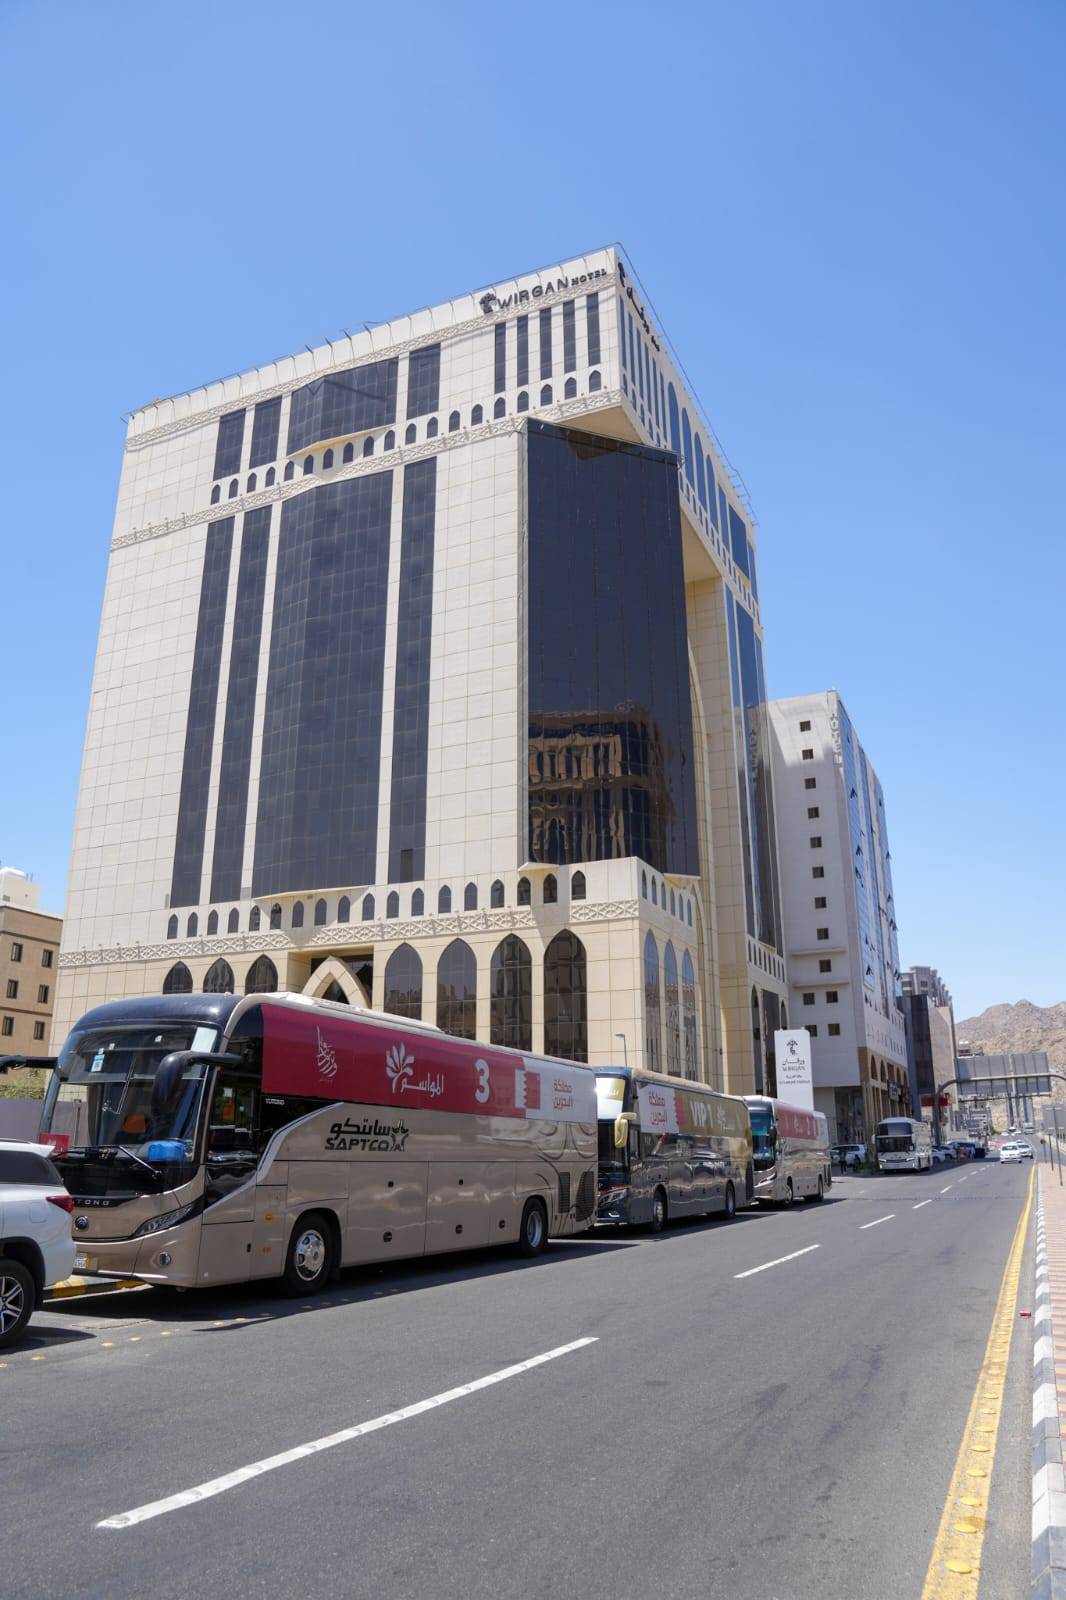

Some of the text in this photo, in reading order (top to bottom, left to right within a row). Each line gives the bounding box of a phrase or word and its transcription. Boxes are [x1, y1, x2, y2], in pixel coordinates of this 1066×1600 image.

[497, 268, 608, 310] WIRGAN HOTEL
[400, 1071, 445, 1098] المواسم
[474, 1058, 491, 1104] 3
[689, 1100, 707, 1129] VIP
[324, 1136, 391, 1152] SAPTCO
